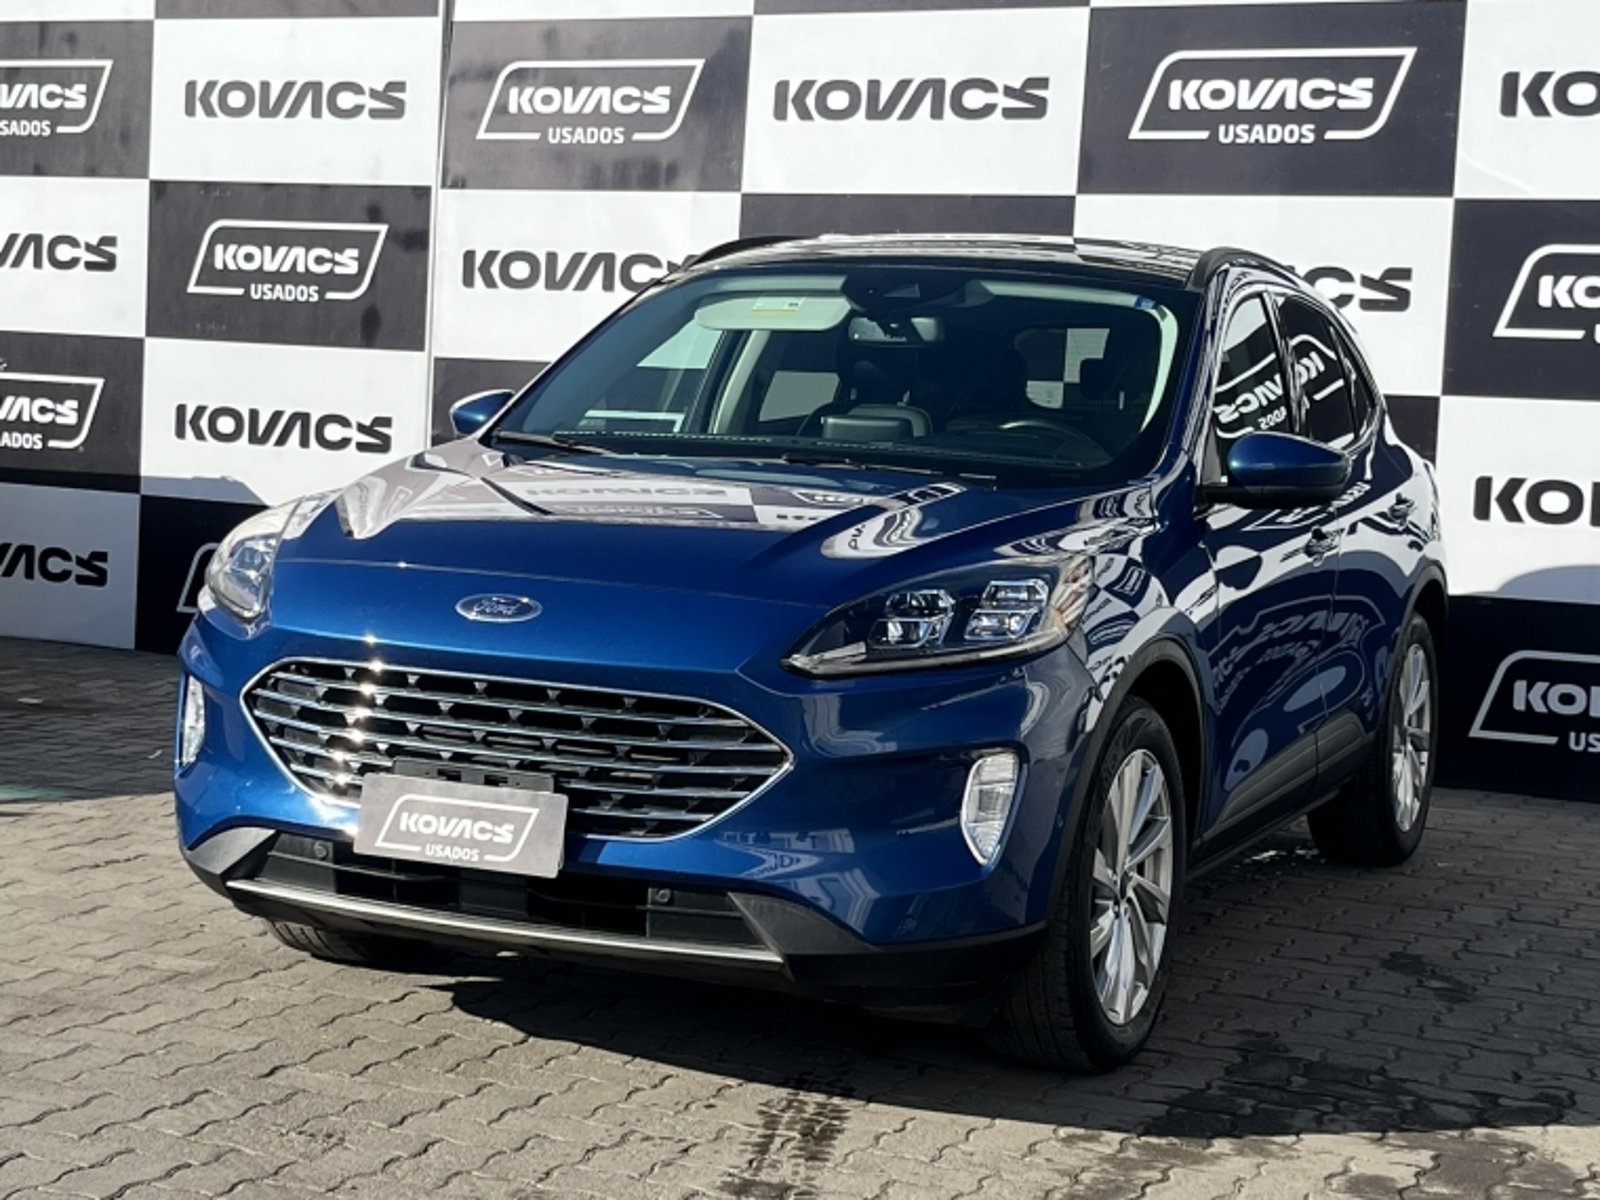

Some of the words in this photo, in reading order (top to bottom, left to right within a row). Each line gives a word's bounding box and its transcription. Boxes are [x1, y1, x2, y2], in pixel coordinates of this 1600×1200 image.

[0, 84, 86, 109] VACS
[185, 80, 406, 119] KOVACS
[509, 86, 670, 113] KOVACS
[774, 77, 1049, 120] KOVACS
[1169, 78, 1373, 110] KOVACS
[548, 127, 624, 143] USADOS
[1219, 124, 1314, 143] USADOS
[215, 244, 358, 274] KOVACS
[251, 284, 318, 301] USADOS
[175, 404, 392, 453] KOVACS
[1474, 476, 1600, 527] KO
[399, 811, 516, 844] KOVACS
[424, 842, 481, 863] USADOS
